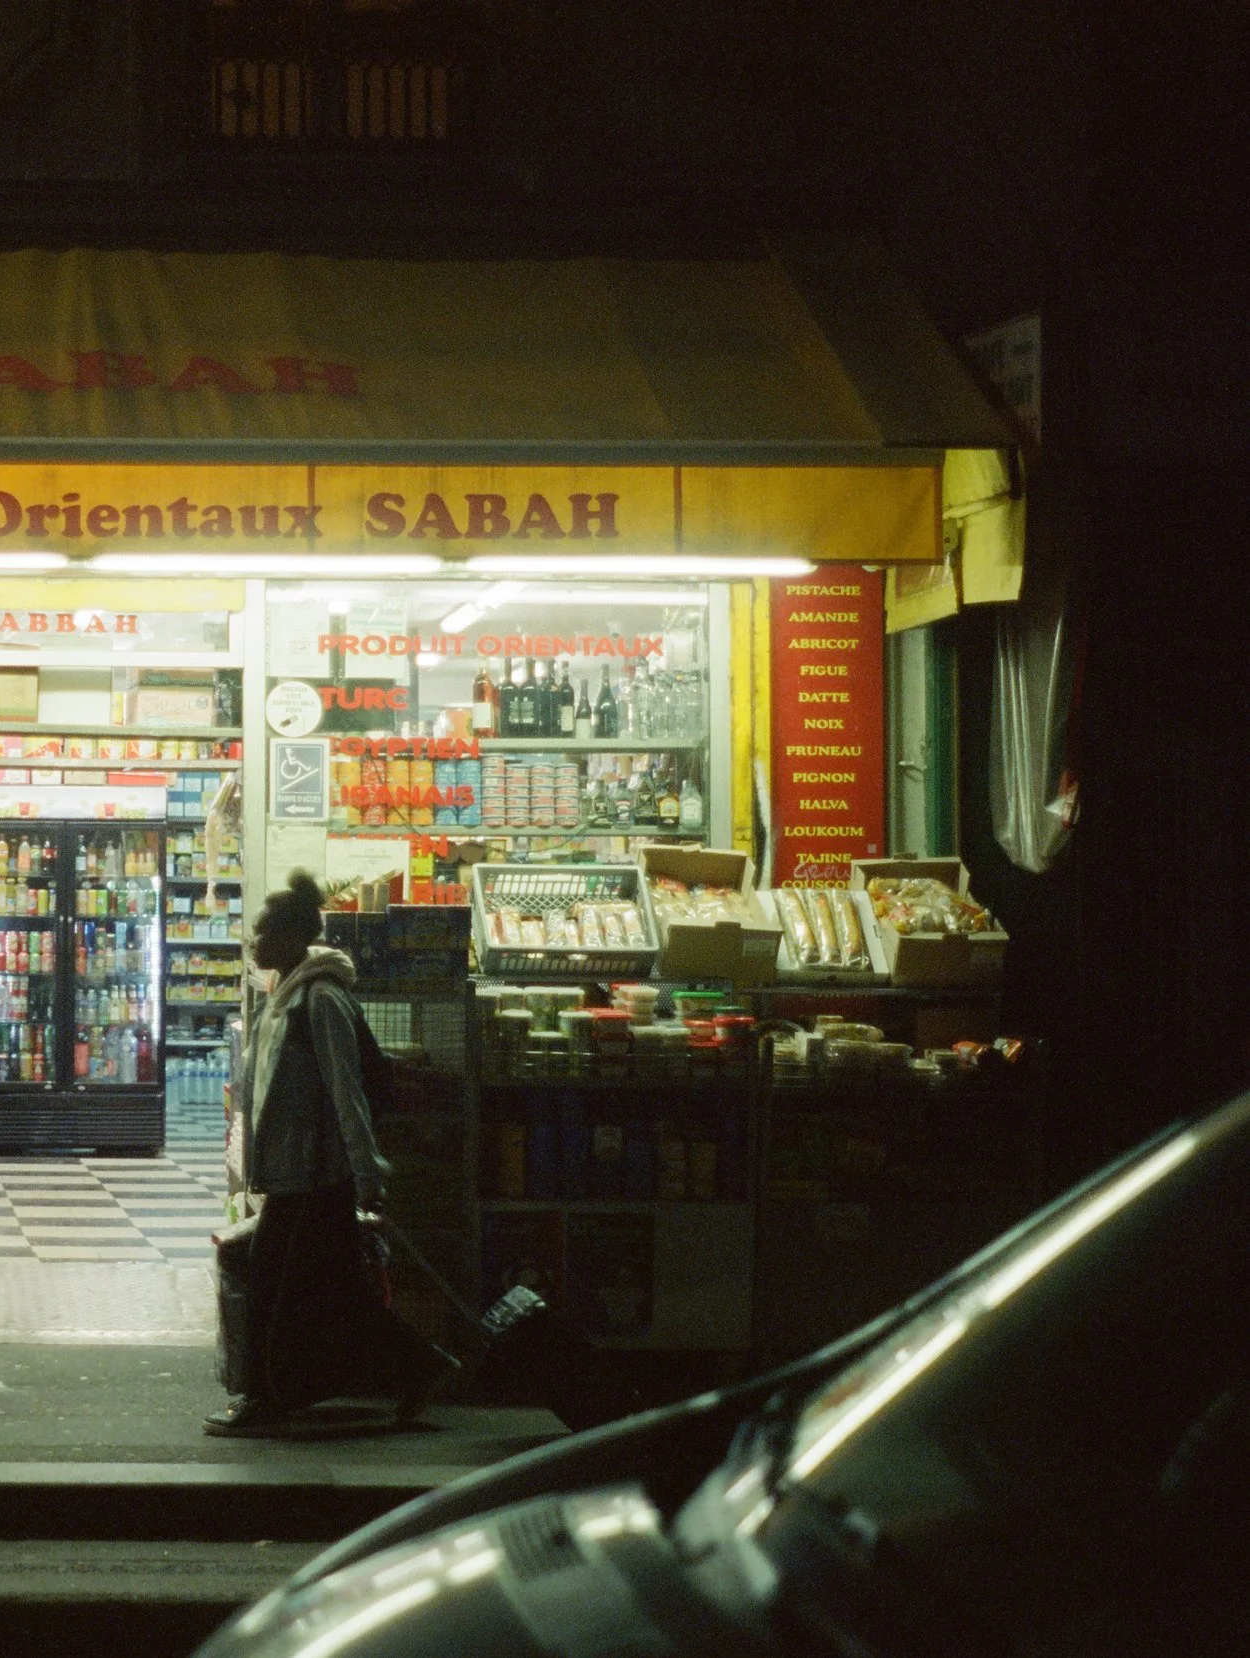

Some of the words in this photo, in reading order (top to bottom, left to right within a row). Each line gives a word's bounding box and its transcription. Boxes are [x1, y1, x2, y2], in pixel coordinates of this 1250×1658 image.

[364, 491, 620, 540] SABAH
[786, 585, 862, 596] PISTACHE
[788, 612, 859, 623] AMANDE
[317, 633, 468, 657] PRODUIT
[475, 634, 665, 658] ORIENTAUX
[788, 638, 859, 650] ABRICOT
[800, 665, 848, 677] FIGUE
[317, 685, 410, 711] TURC
[798, 692, 850, 703] DATTE
[804, 718, 844, 730] NOIX
[786, 745, 862, 757] PRUNEAU
[792, 772, 856, 783] PIGNON
[330, 784, 476, 809] IBANAIS
[800, 799, 849, 810] HALVA
[784, 826, 864, 837] LOUKOUM
[796, 853, 852, 864] TAJINE
